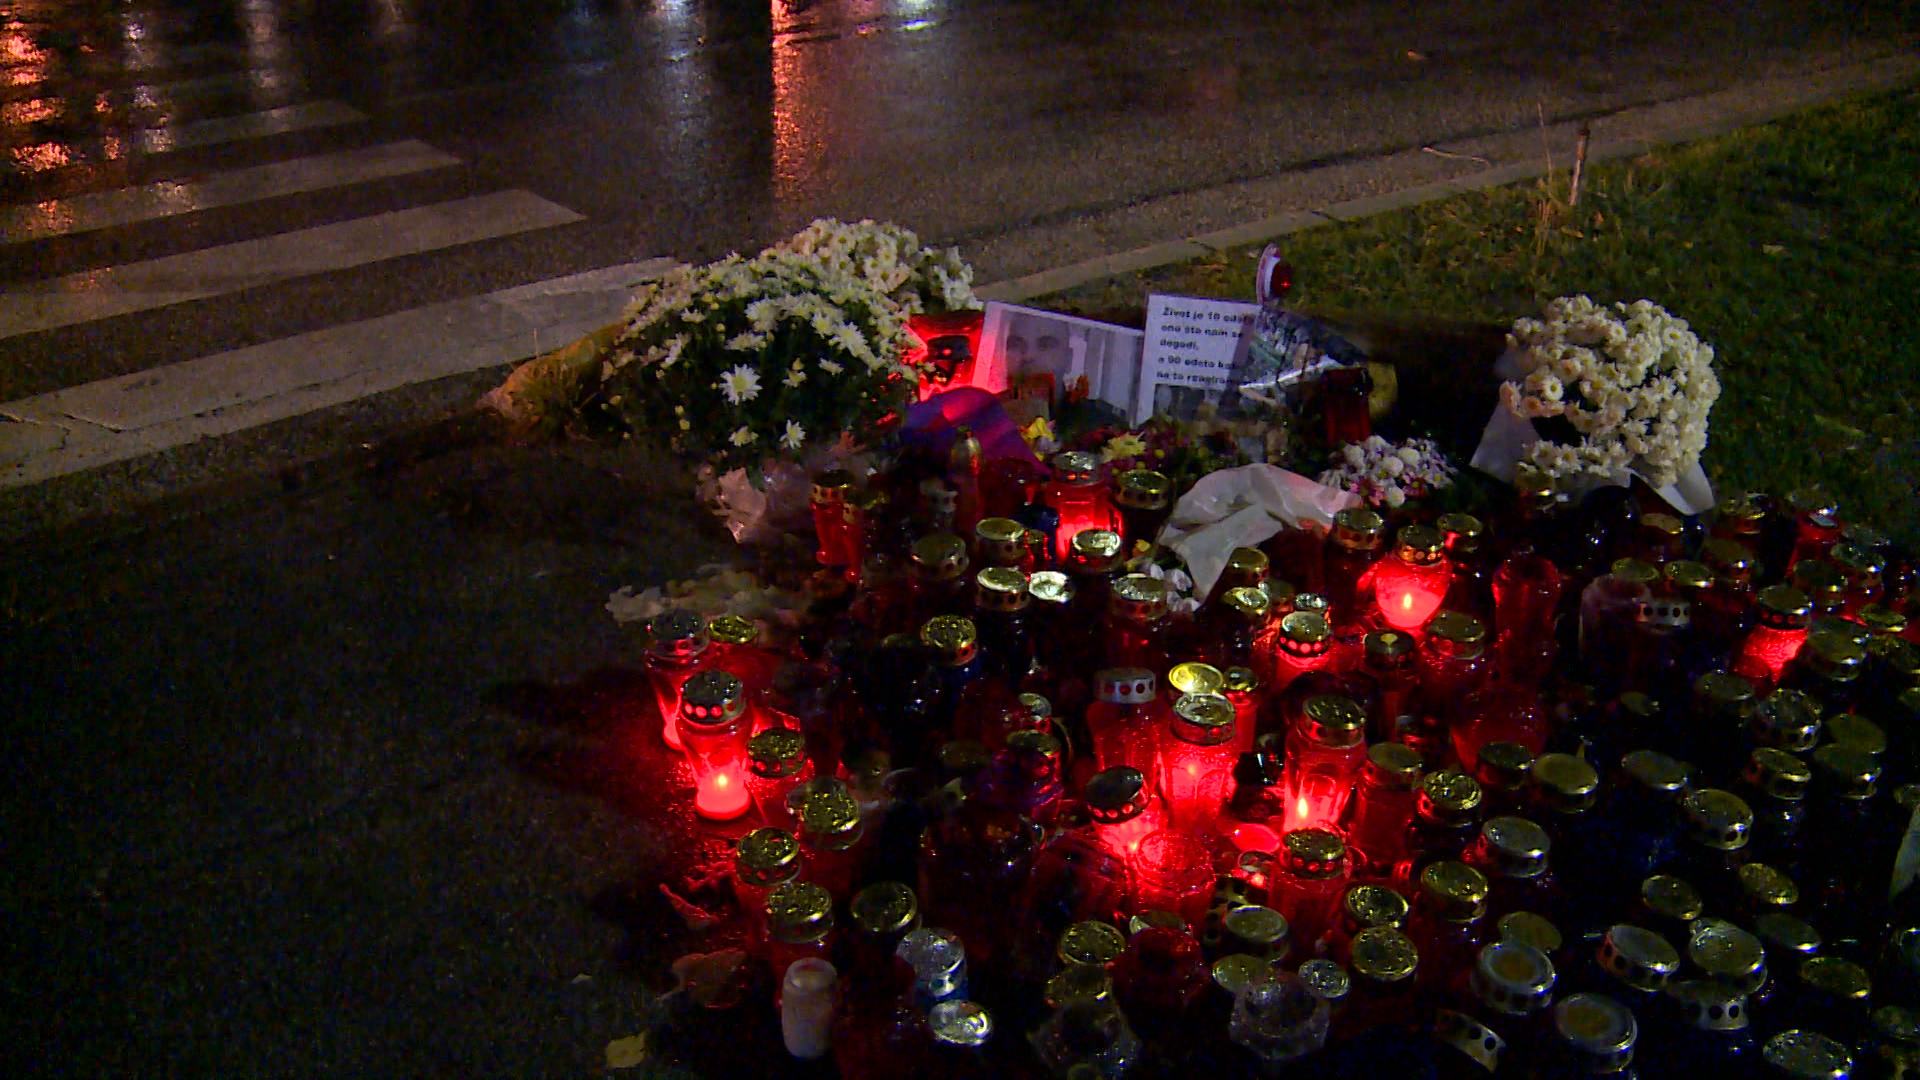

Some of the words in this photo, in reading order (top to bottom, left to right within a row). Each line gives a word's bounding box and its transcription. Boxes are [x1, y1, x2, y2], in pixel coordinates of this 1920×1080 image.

[1163, 306, 1190, 318] Život
[1192, 311, 1204, 321] je
[1207, 311, 1221, 321] 10
[1161, 324, 1181, 333] ono
[1204, 328, 1229, 337] nam
[1167, 354, 1181, 364] 90
[1184, 358, 1215, 368] odsto
[1156, 370, 1170, 379] na
[1173, 371, 1185, 380] to
